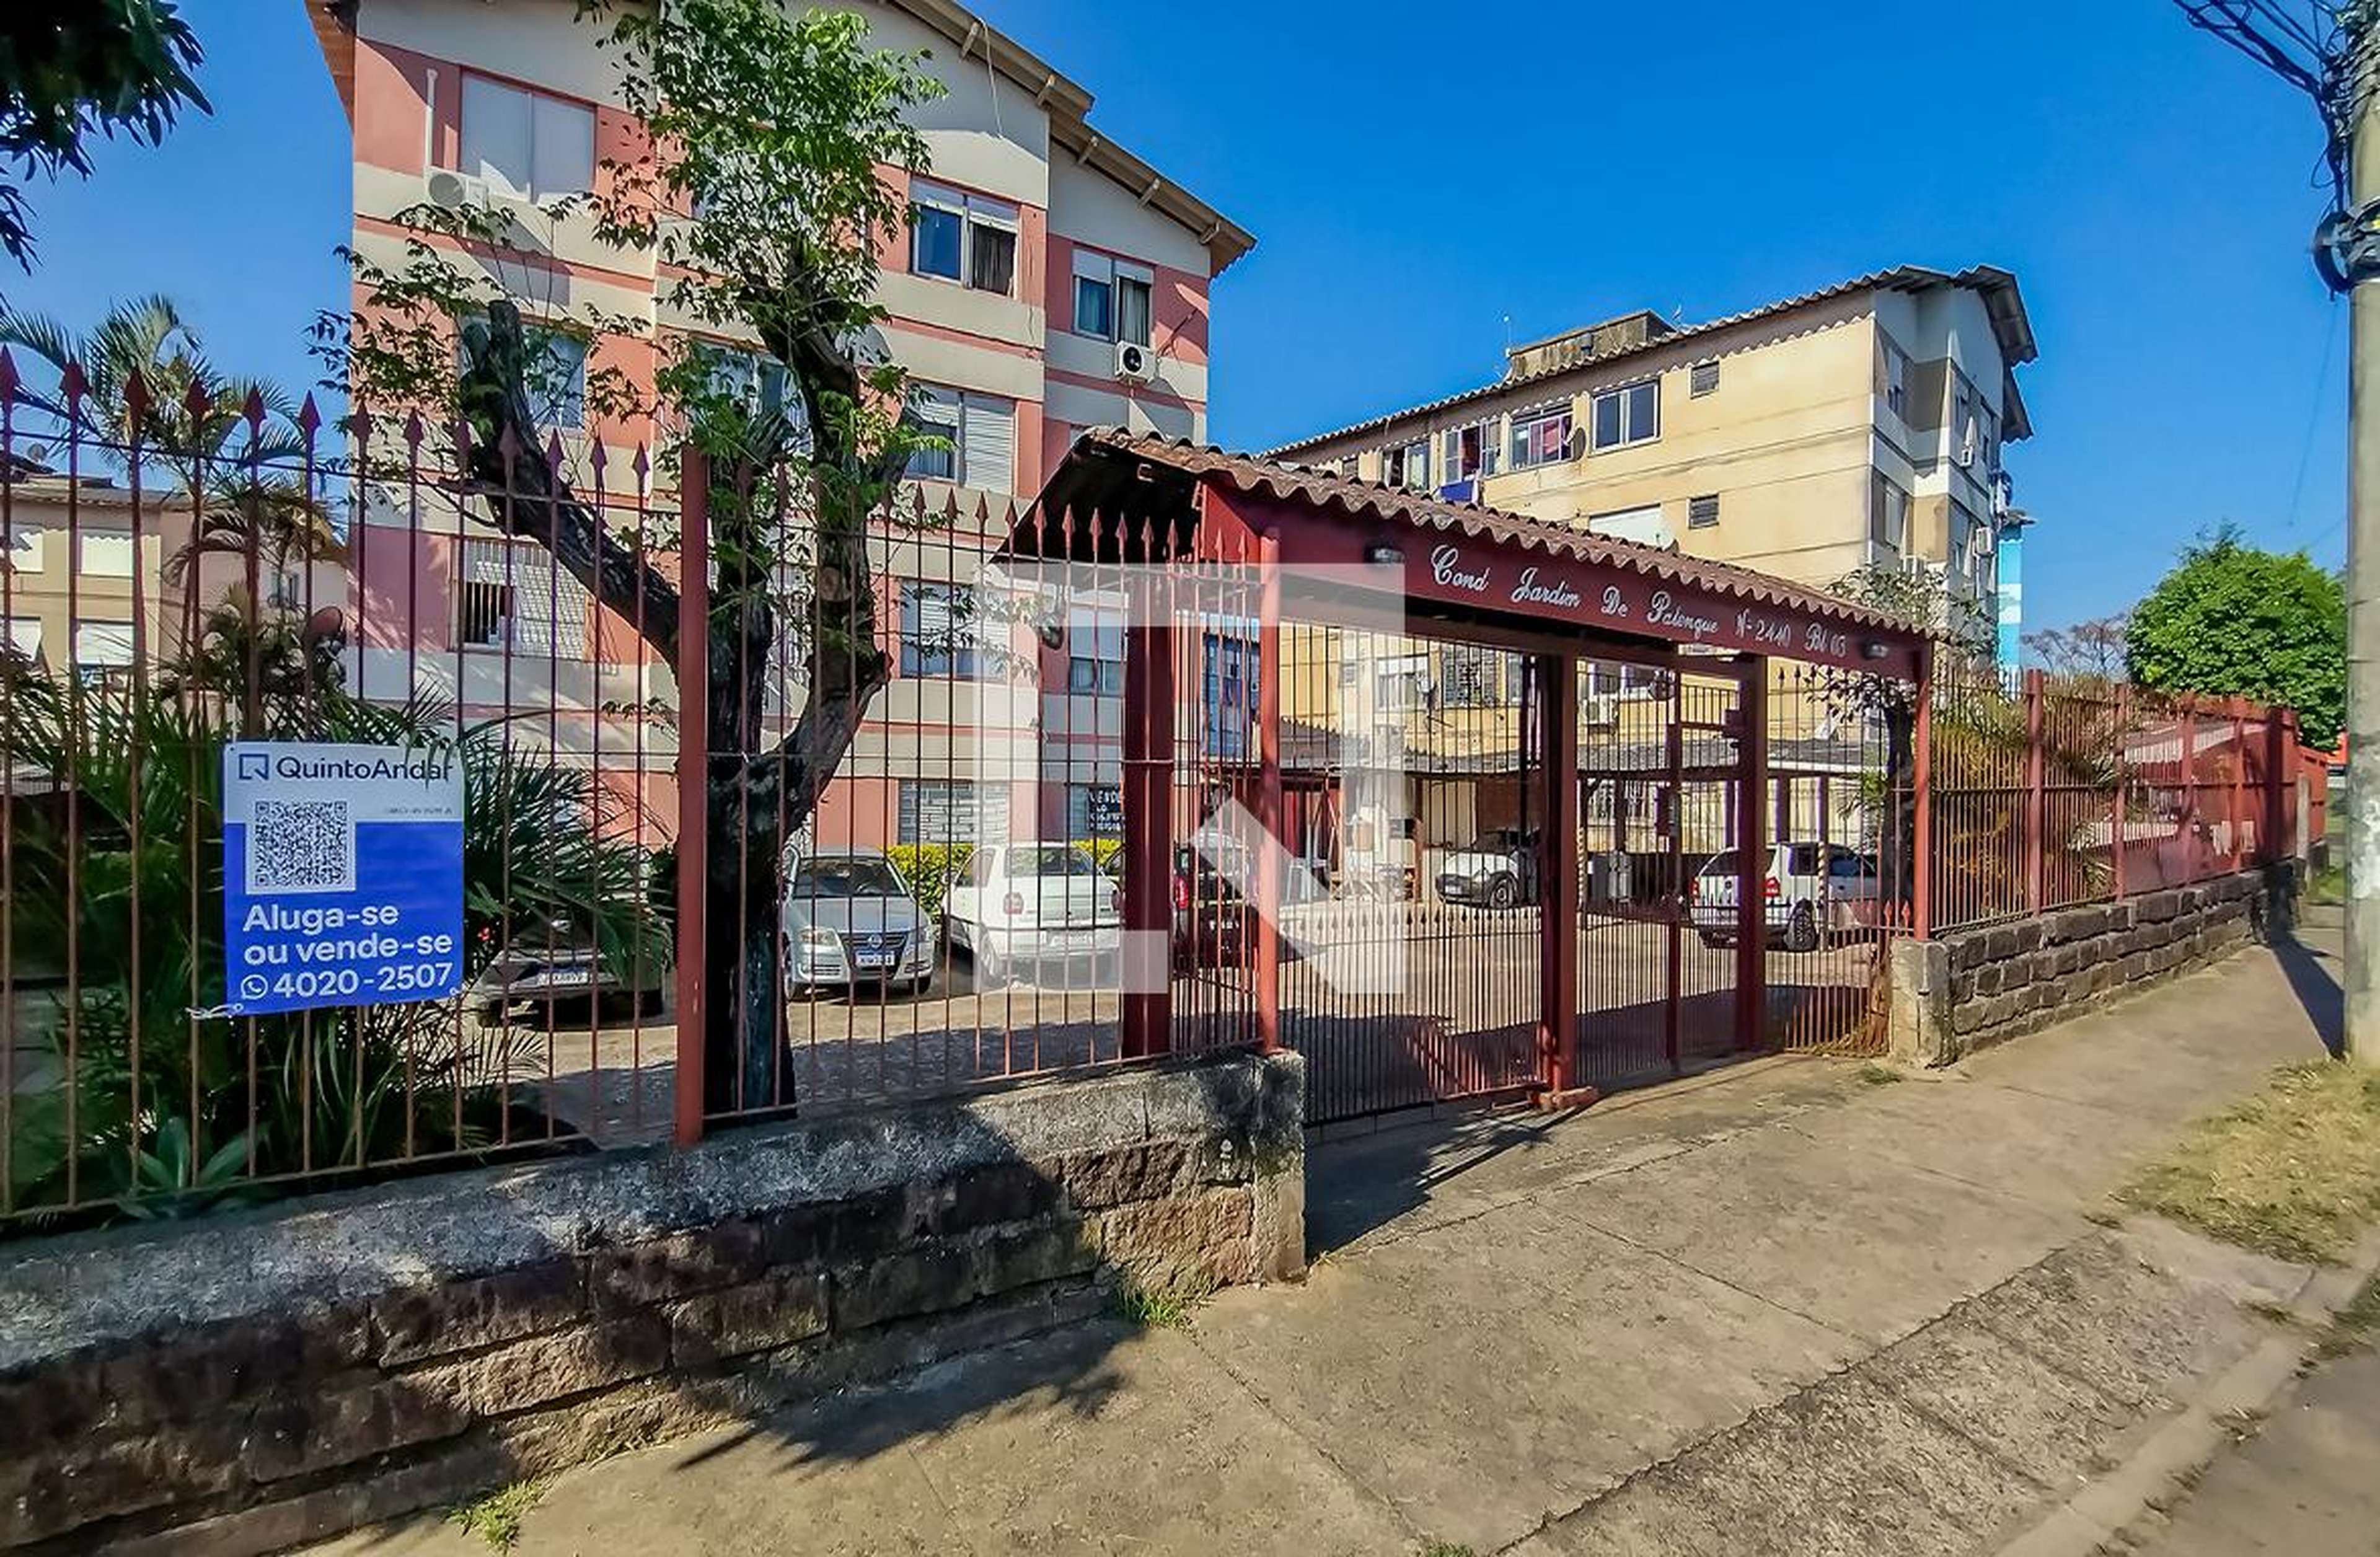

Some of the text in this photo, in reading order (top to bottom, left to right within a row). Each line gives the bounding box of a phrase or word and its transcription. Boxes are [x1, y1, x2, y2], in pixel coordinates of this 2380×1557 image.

[1431, 544, 1491, 592] Cond
[1510, 567, 1582, 609] Jardim
[1600, 585, 1629, 617] De
[276, 756, 454, 780] QuintoAndar
[242, 904, 399, 935] Aluga-se
[244, 932, 453, 965] ou vende-se
[273, 962, 454, 999] 4020-2507
